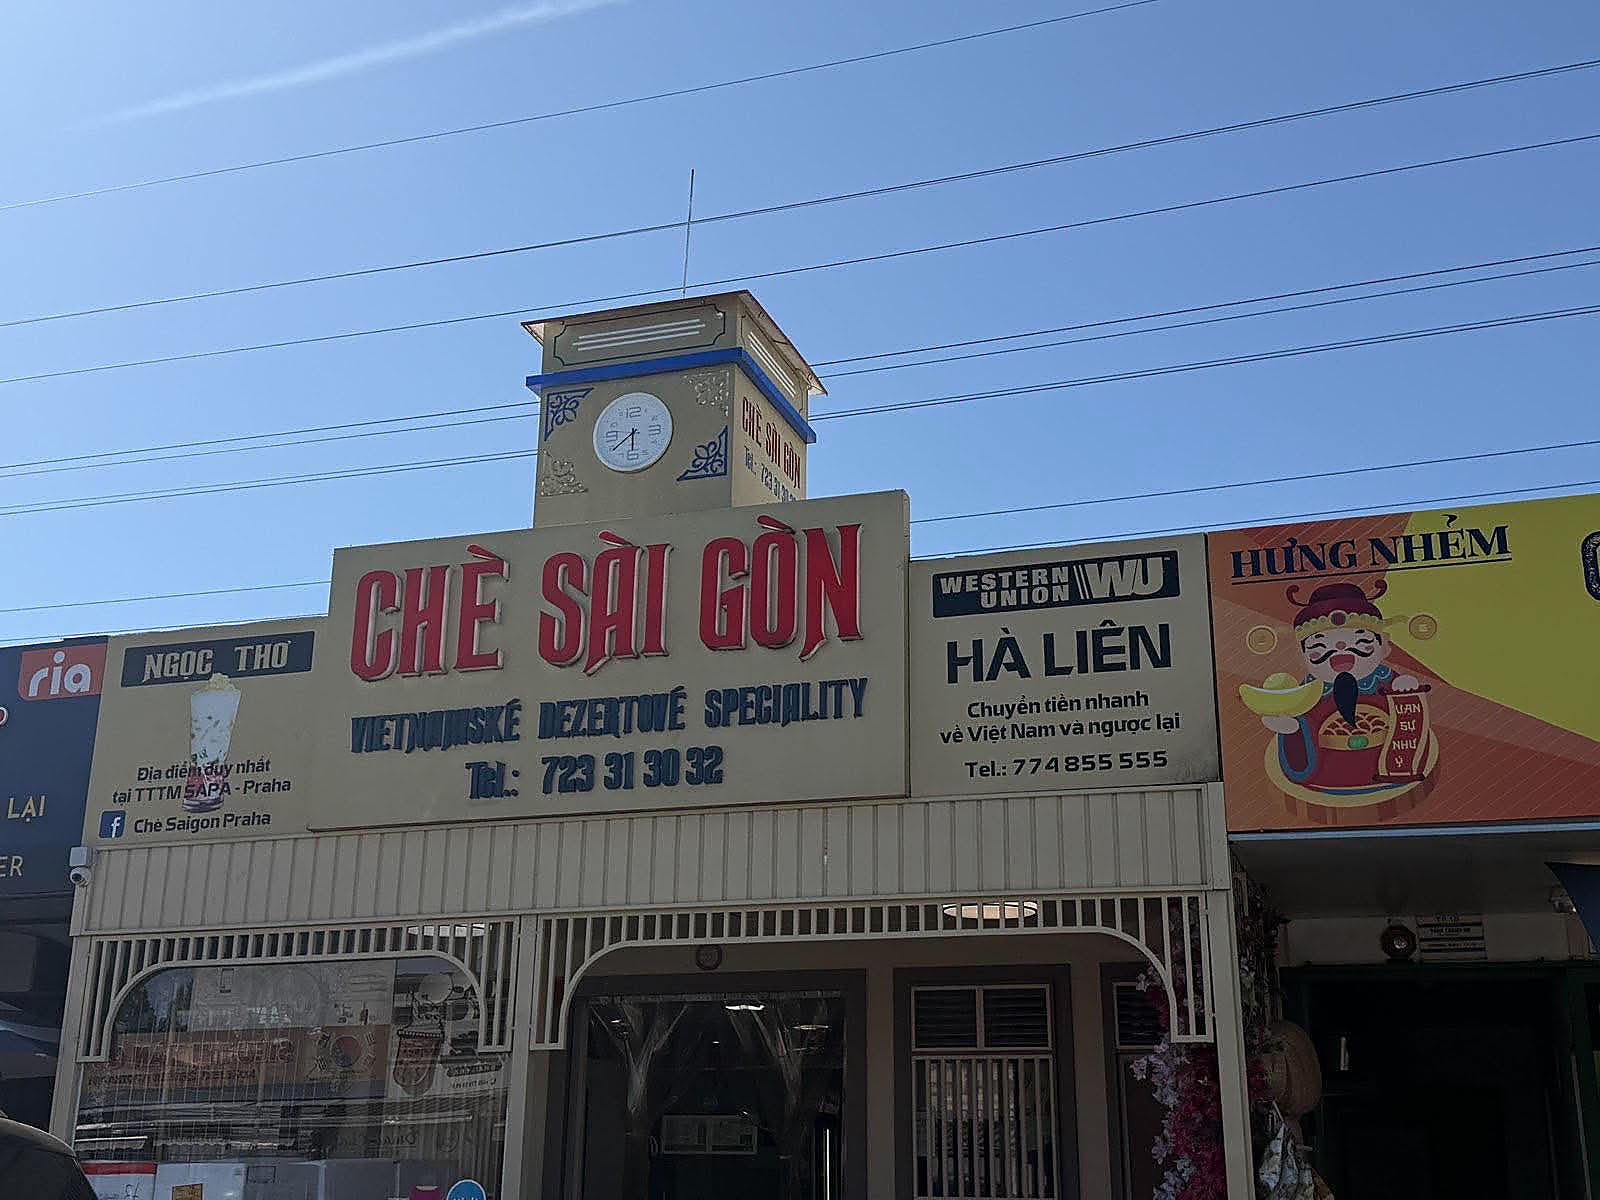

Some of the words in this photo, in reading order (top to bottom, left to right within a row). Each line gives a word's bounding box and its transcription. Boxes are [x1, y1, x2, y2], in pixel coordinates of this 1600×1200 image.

[1230, 537, 1358, 579] HƯNG
[1368, 514, 1512, 567] NHẺM
[940, 566, 1069, 594] WESTERN
[1085, 557, 1165, 599] WU
[351, 544, 511, 682] CHÈ
[538, 531, 674, 676] SÀI
[699, 515, 865, 662] GÒN
[980, 584, 1069, 609] UNION
[142, 648, 214, 684] NGỌC
[946, 627, 1032, 685] HÀ
[1043, 619, 1172, 678] LIÊN
[28, 651, 92, 697] ria
[538, 686, 688, 739] DEZERTOVÉ
[704, 677, 868, 727] SPECIALITY
[967, 695, 1041, 720] Chuyển
[1044, 693, 1081, 713] tiền
[1085, 690, 1149, 710] nhanh
[940, 724, 964, 744] về
[968, 724, 1007, 744] Việt
[1011, 722, 1056, 740] Nam
[1060, 719, 1084, 737] và
[1156, 712, 1180, 733] lại
[541, 754, 597, 795] 723
[603, 751, 635, 790] 31
[642, 748, 681, 788] 30
[685, 745, 724, 786] 32
[964, 760, 1007, 778] Tel.:
[1013, 757, 1059, 776] 774
[1064, 753, 1113, 773] 855
[1119, 750, 1168, 770] 555
[7, 795, 46, 823] LẠI
[112, 789, 131, 806] tại
[135, 785, 182, 802] TTTM
[184, 782, 232, 799] SAPA
[243, 779, 291, 796] Praha
[166, 815, 220, 834] Saigon
[223, 811, 271, 828] Praha
